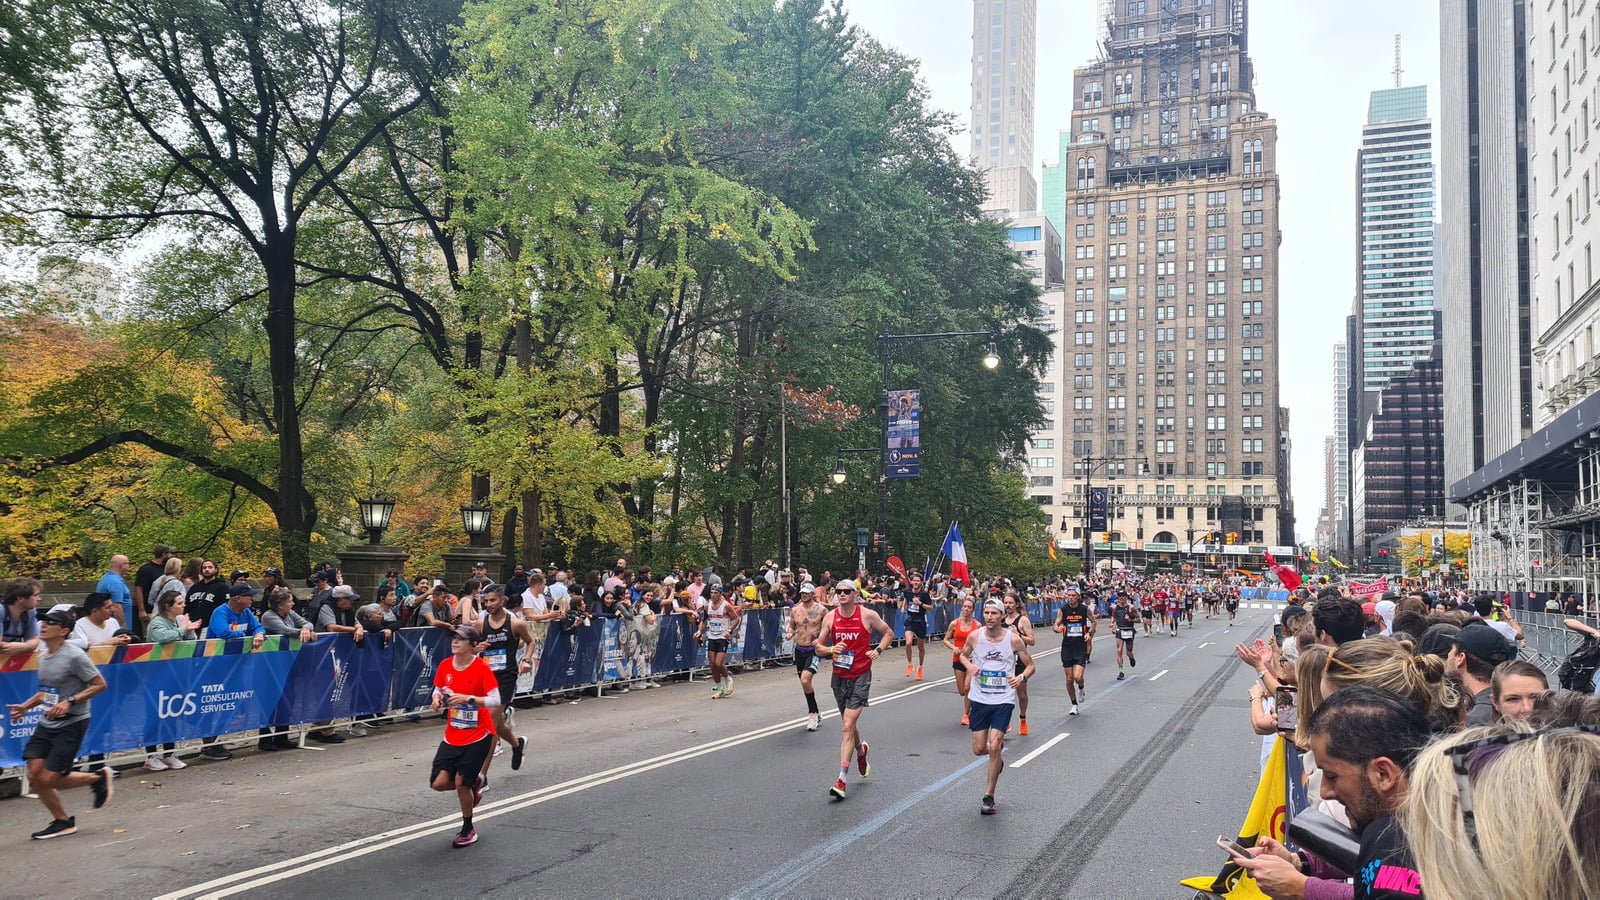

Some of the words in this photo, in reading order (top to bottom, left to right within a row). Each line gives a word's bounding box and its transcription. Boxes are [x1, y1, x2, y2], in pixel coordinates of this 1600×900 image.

[835, 632, 859, 640] FDNY
[201, 684, 224, 693] TATA
[201, 690, 254, 703] CONSULTANCY
[158, 690, 197, 719] tcs
[200, 702, 236, 714] SERVICES
[10, 727, 36, 739] SERV
[1373, 864, 1423, 895] NIKE
